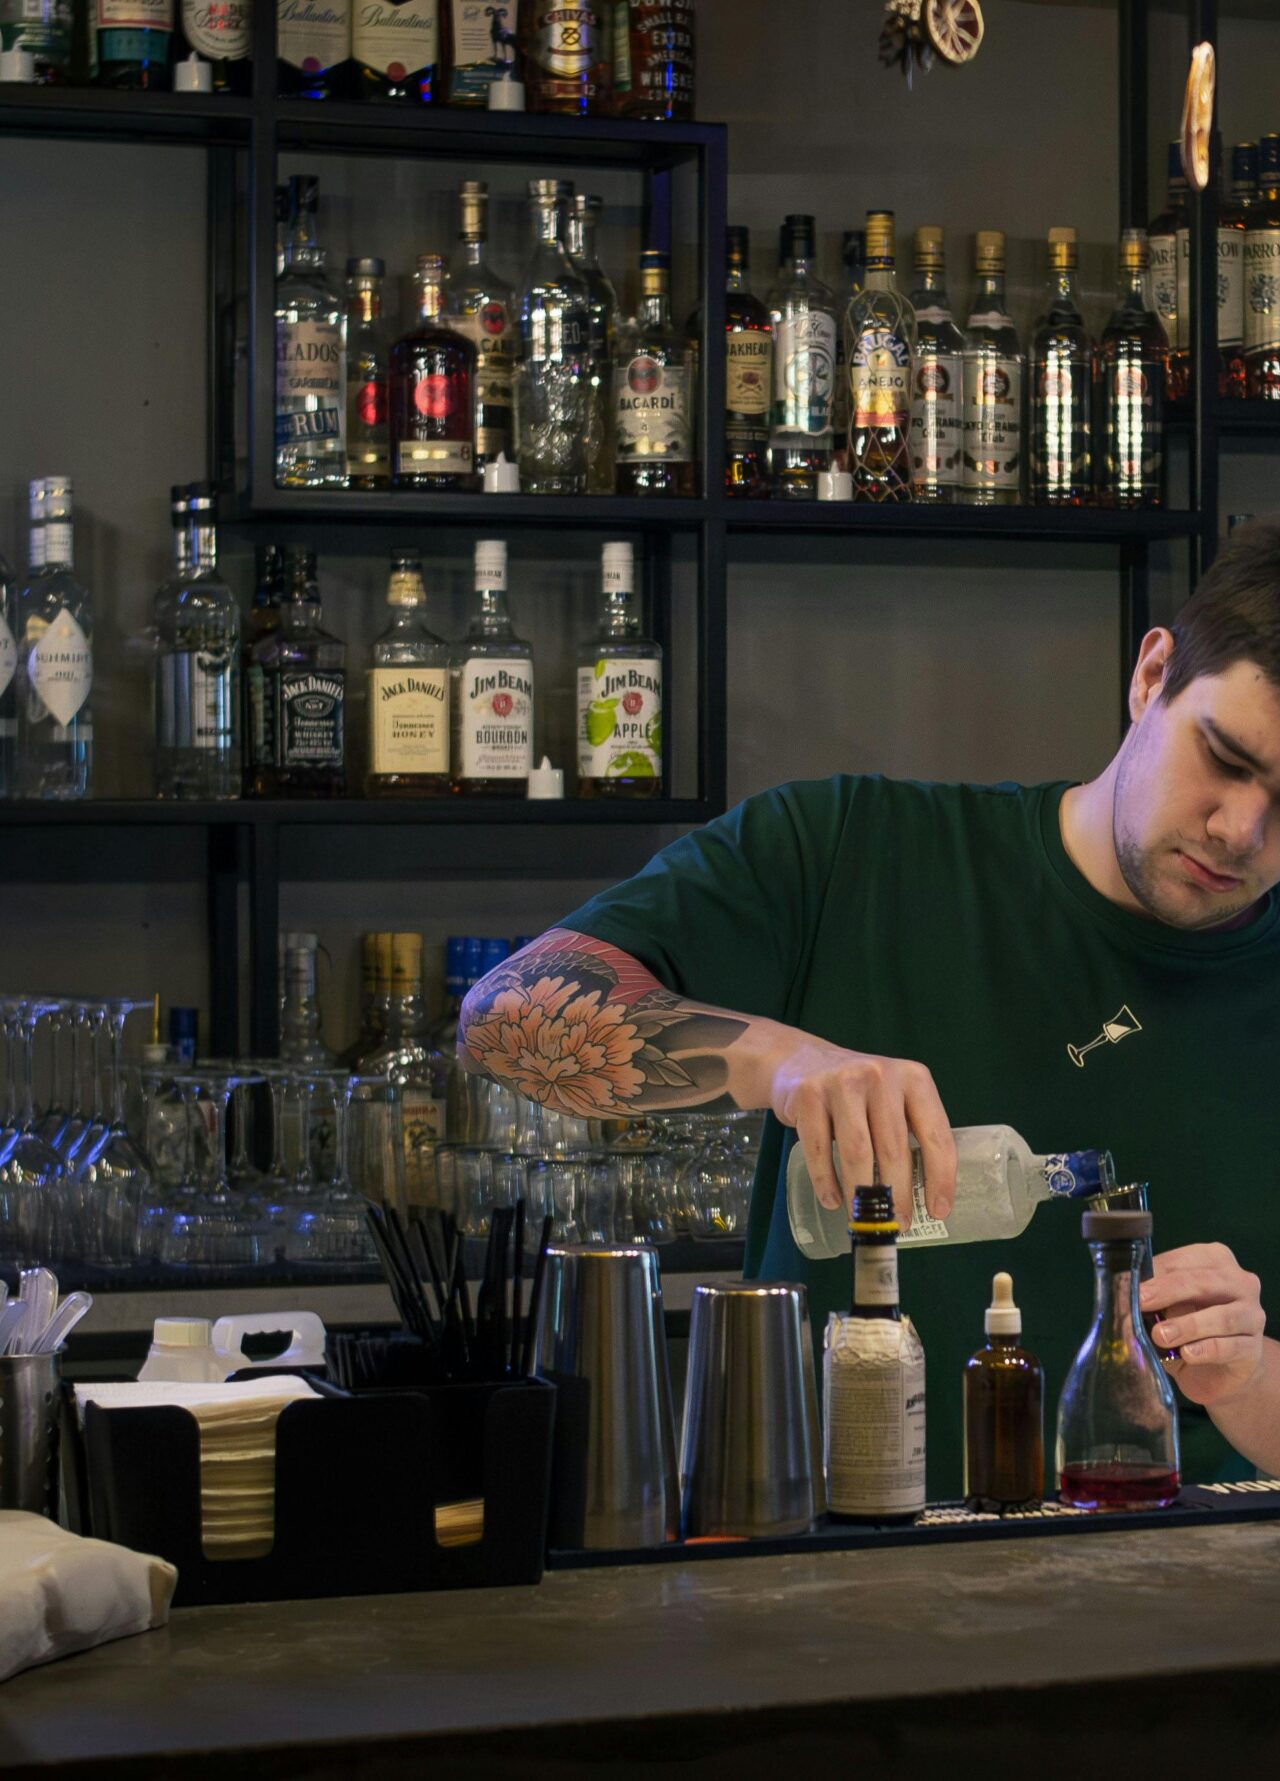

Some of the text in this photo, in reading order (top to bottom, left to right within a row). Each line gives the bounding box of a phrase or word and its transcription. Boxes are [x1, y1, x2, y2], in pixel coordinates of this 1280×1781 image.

[543, 9, 597, 26] CHIVAS
[282, 680, 308, 701] JACK
[382, 682, 406, 702] JACK
[471, 670, 532, 699] JIM BEAM
[601, 675, 626, 698] JIM
[392, 730, 435, 739] HONEY
[475, 730, 528, 745] BOURBON
[613, 722, 651, 739] APPLE
